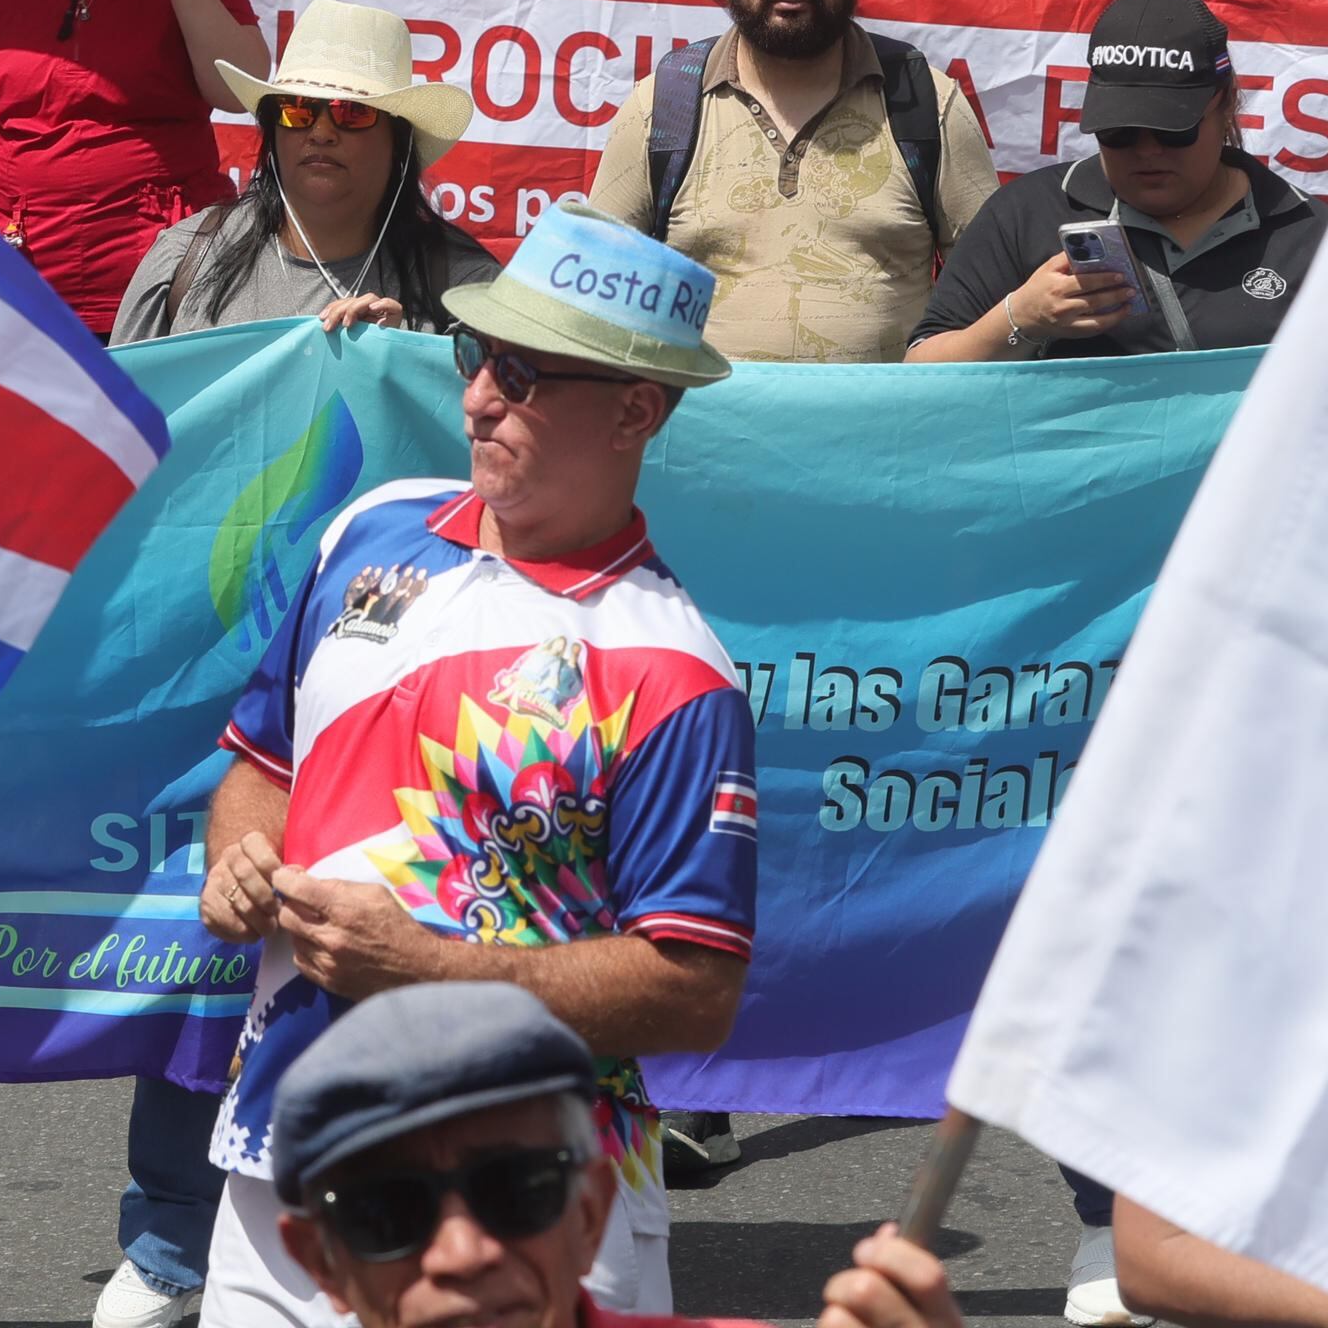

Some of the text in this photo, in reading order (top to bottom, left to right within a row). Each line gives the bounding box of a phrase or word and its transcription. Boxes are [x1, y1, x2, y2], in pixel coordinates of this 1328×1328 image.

[1091, 44, 1195, 73] #YOSOYTICA
[550, 253, 662, 314] Costa
[783, 651, 903, 732] las
[68, 933, 120, 981] el
[115, 933, 251, 989] futuro
